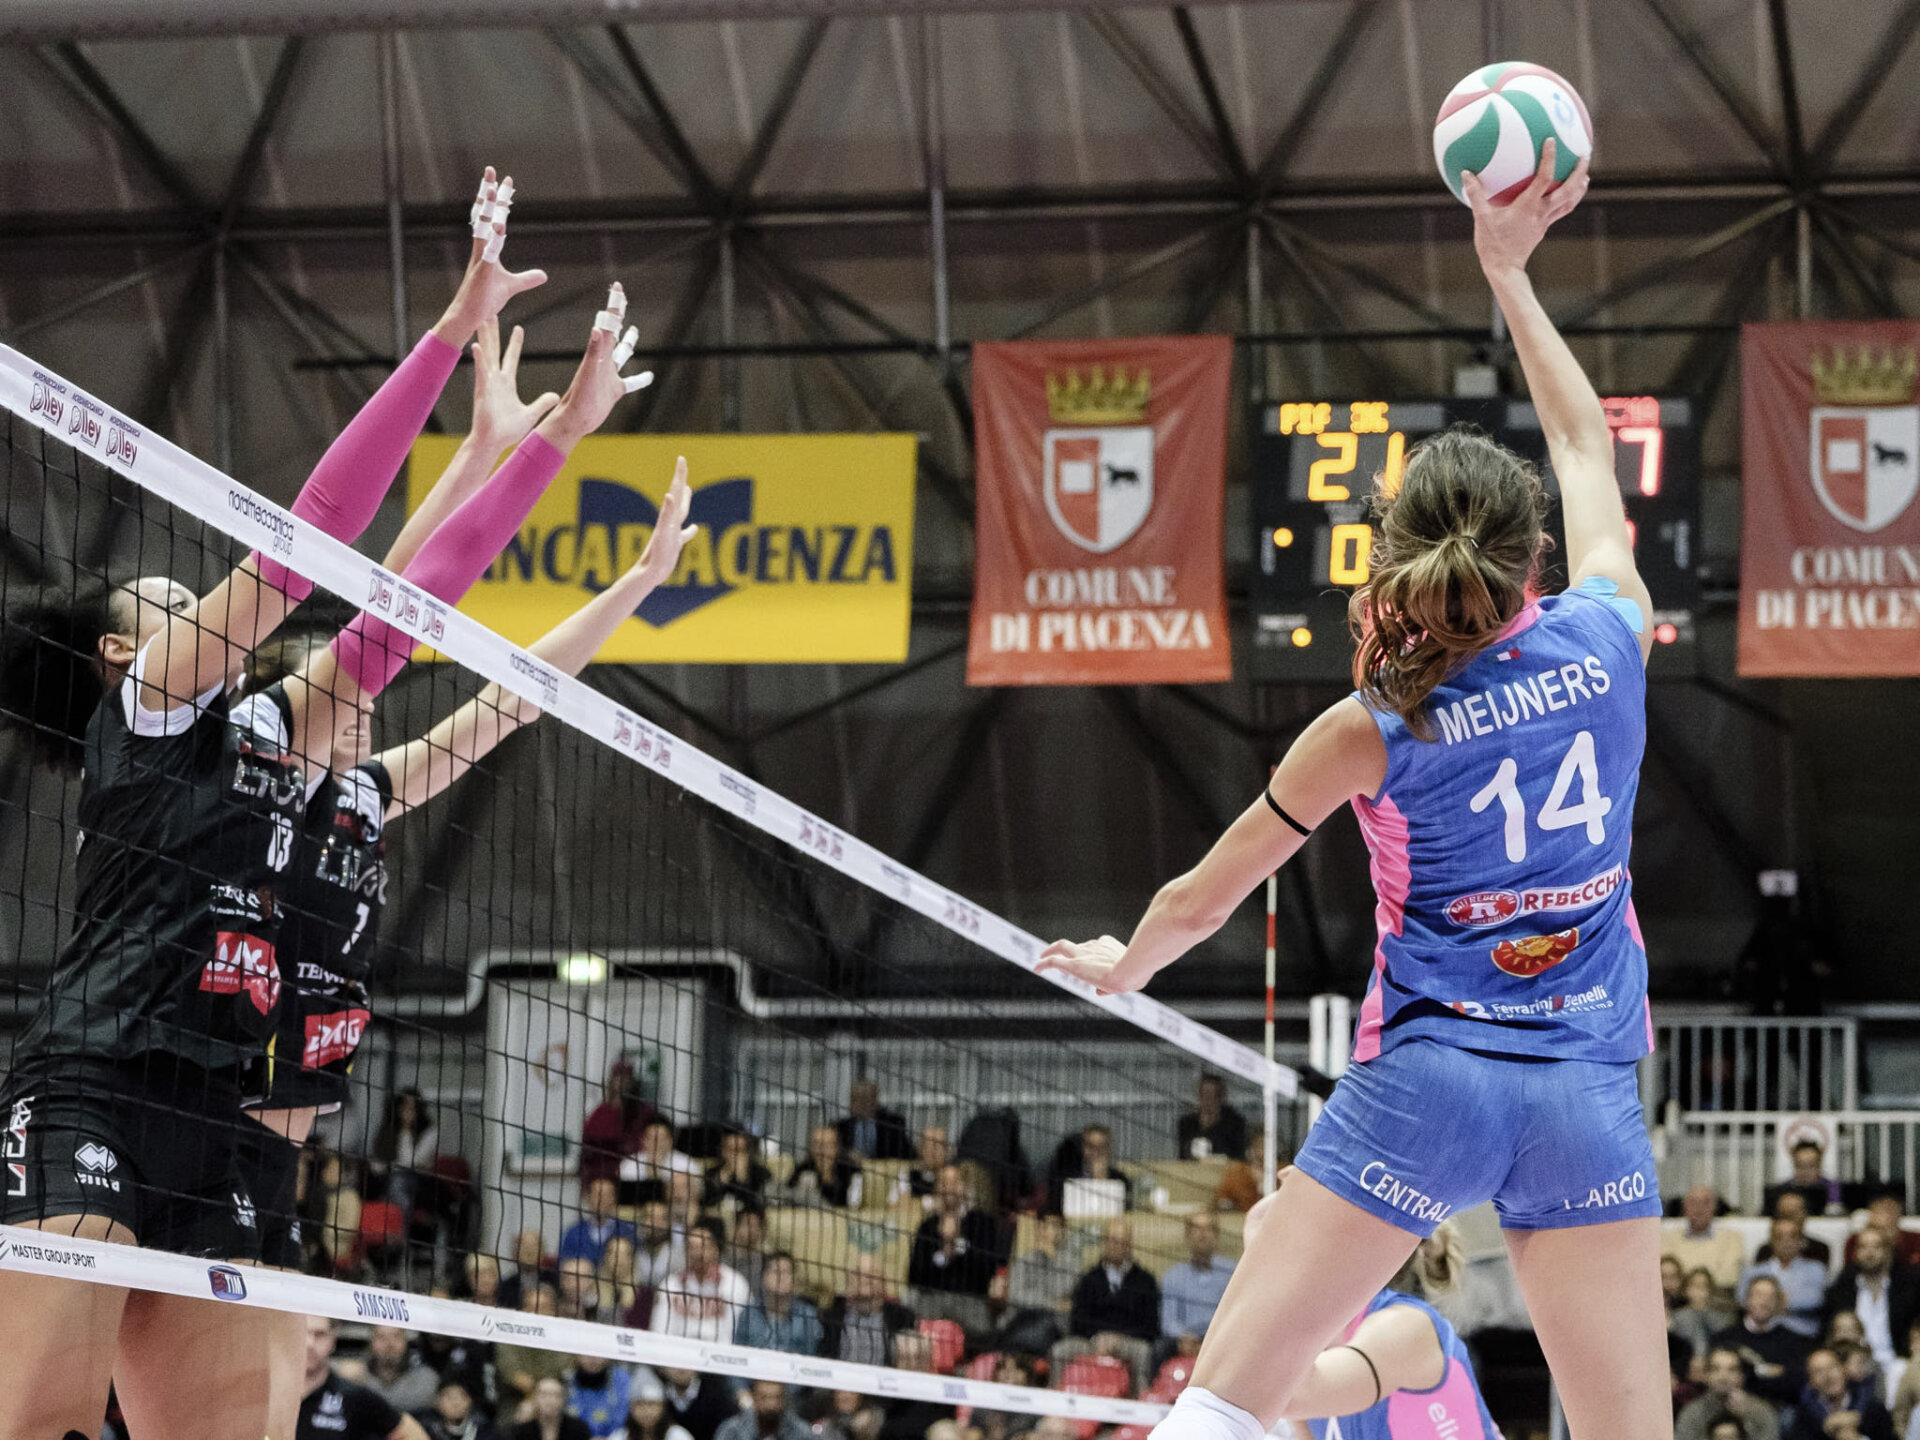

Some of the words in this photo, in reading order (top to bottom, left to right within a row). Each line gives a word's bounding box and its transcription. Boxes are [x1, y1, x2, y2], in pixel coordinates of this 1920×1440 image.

[1608, 426, 1663, 497] 7
[1025, 567, 1176, 606] COMUNE
[1805, 588, 1919, 629] PIACE
[991, 612, 1029, 651] DI
[1038, 609, 1212, 650] PIACENZA
[1435, 655, 1611, 746] MEIJNERS
[1469, 730, 1612, 863] 14
[266, 811, 294, 873] 13
[1490, 996, 1553, 1015] Ferrarini
[1563, 985, 1608, 1008] Benelli
[1360, 1161, 1452, 1222] CENTRAL
[11, 1243, 44, 1260] MASTER
[44, 1248, 72, 1264] GROUP
[71, 1253, 97, 1269] SPORT
[353, 1291, 410, 1322] SAMSUNG
[1428, 1402, 1460, 1440] eli
